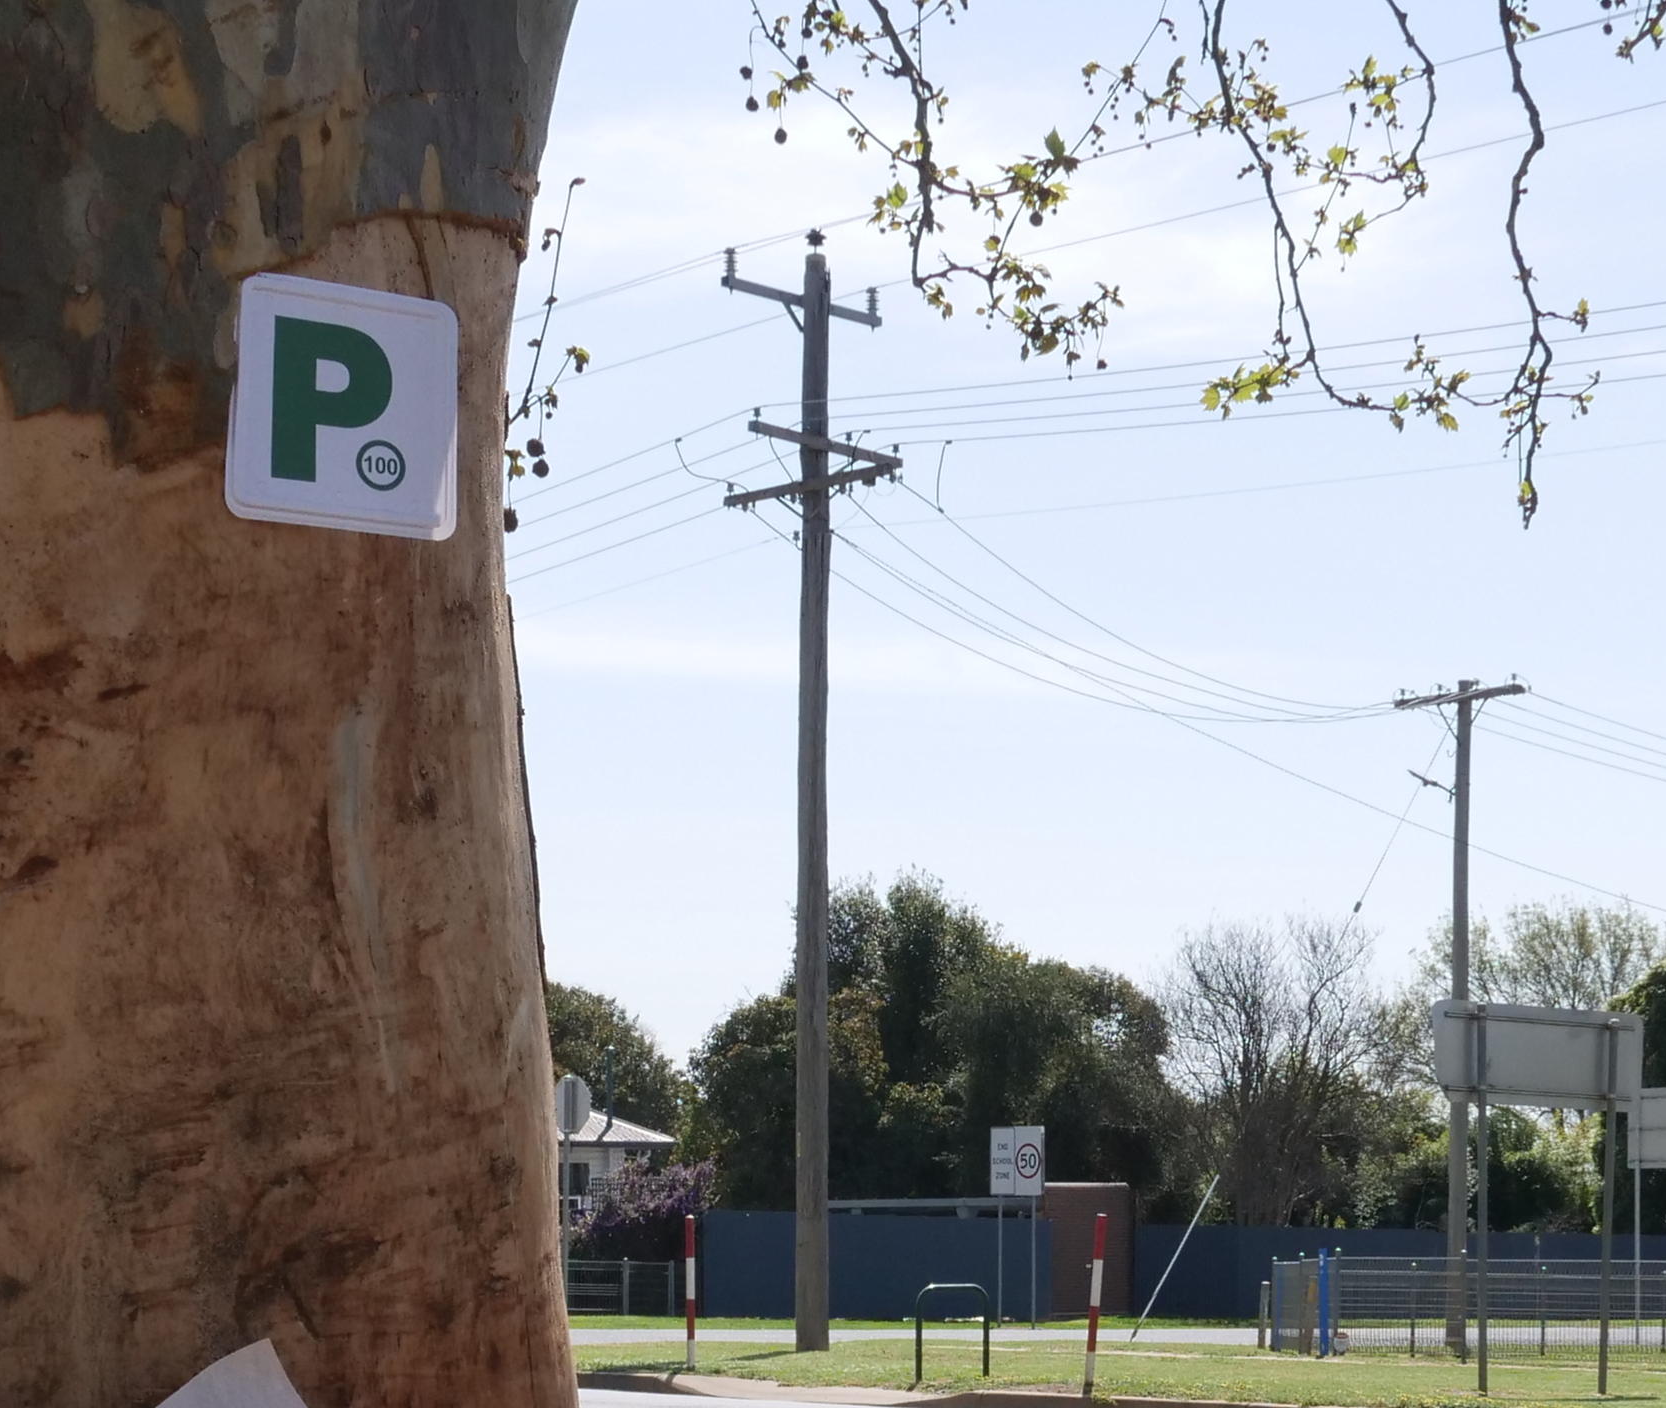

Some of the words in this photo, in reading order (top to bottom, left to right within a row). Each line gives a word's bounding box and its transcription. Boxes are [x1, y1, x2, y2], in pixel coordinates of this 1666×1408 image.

[271, 315, 392, 482] P
[363, 455, 398, 476] 100
[993, 1157, 1014, 1165] SCHOOL
[1020, 1153, 1037, 1169] 50
